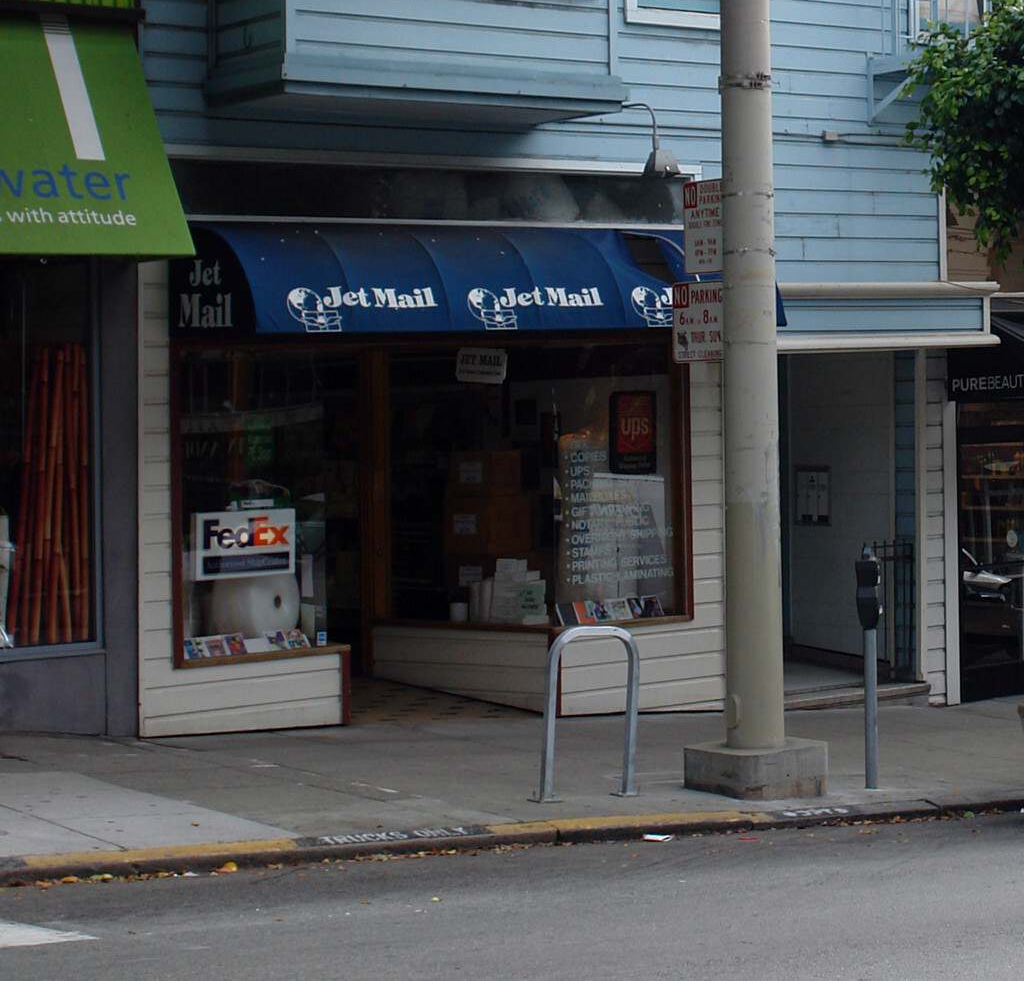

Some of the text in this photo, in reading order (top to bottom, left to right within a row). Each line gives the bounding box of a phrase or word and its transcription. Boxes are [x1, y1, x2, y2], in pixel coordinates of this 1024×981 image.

[685, 184, 697, 207] NO
[699, 193, 723, 206] PARKIN
[6, 206, 137, 226] with attitude
[690, 206, 720, 220] ANYTIME
[189, 259, 222, 287] Jet
[322, 285, 439, 310] Jet Mail
[499, 286, 604, 308] Jet Mail
[674, 286, 688, 307] NO
[690, 287, 723, 305] PARKING
[178, 292, 234, 329] Mail
[460, 353, 502, 367] JET MAIL
[620, 417, 650, 441] ups
[570, 450, 607, 464] COPIES
[570, 465, 590, 477] UPS
[202, 515, 290, 551] FedEx
[571, 546, 612, 559] STAMPS
[571, 553, 668, 572] PRINTING SERVICES
[571, 566, 675, 586] PLASTIC LAMINATING
[318, 826, 469, 845] TRUCKS ONLY
